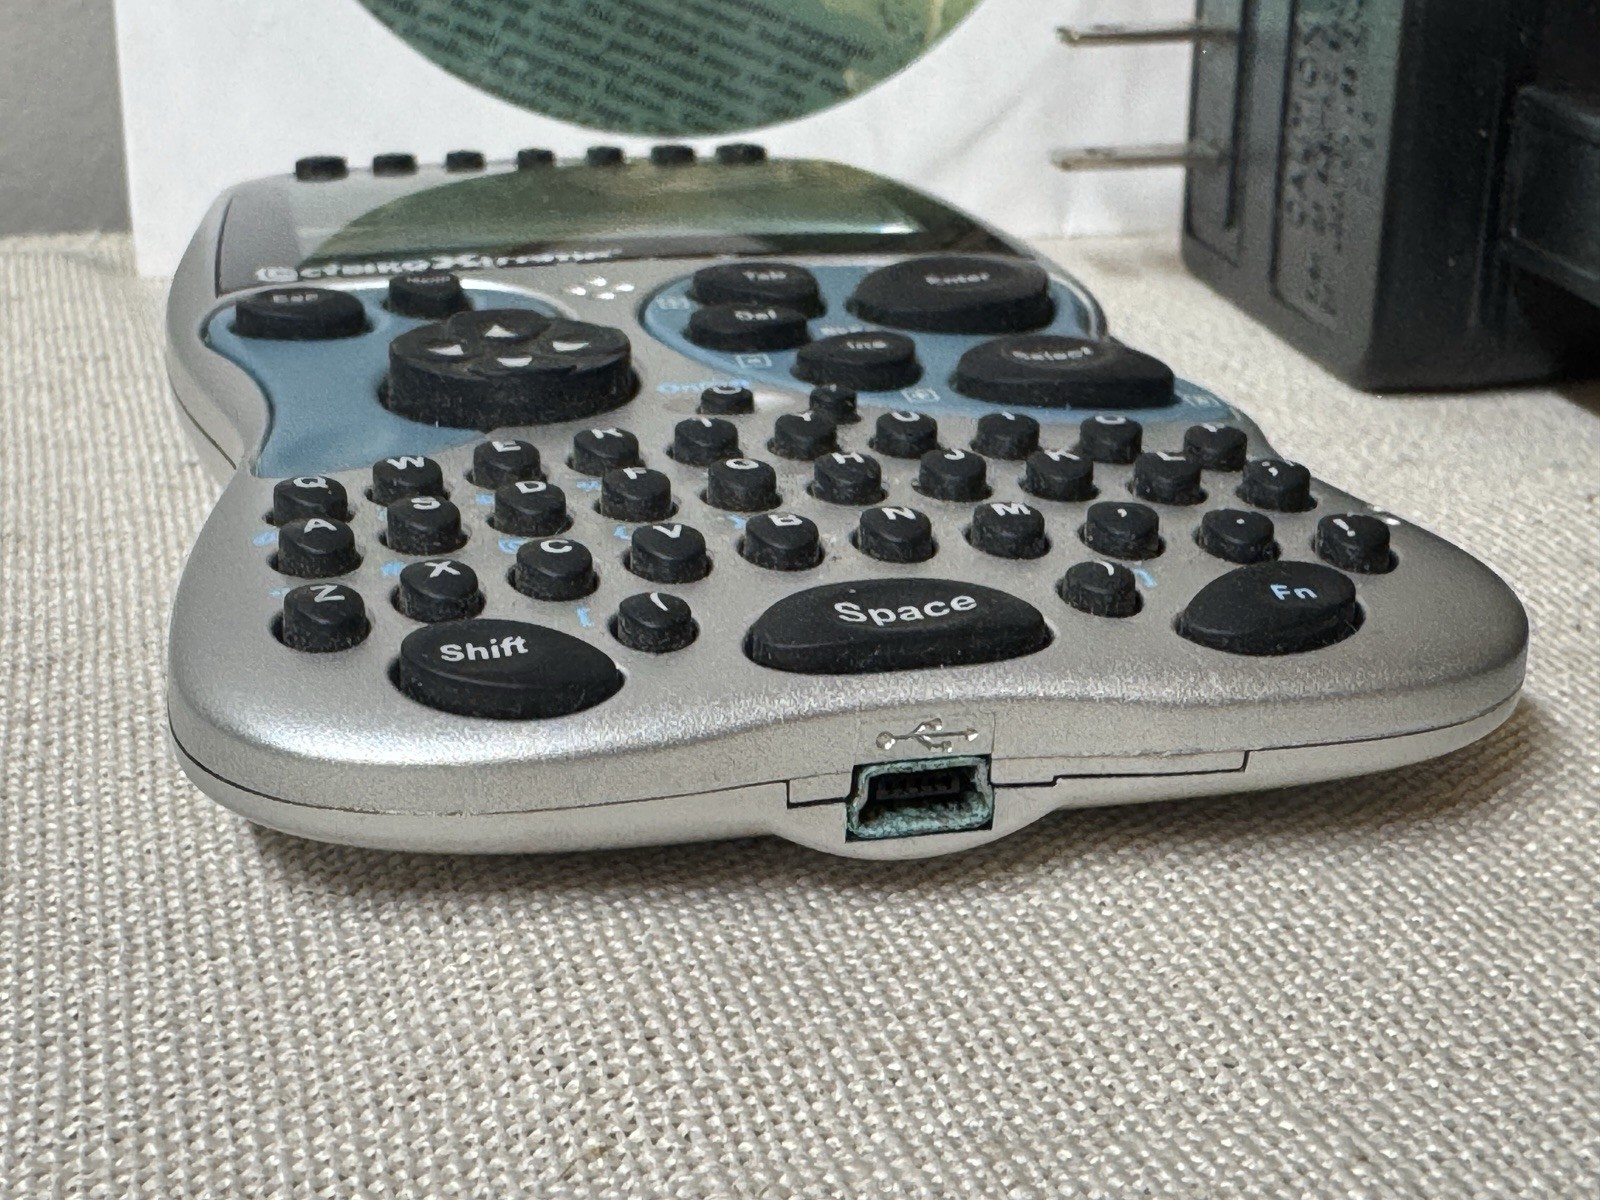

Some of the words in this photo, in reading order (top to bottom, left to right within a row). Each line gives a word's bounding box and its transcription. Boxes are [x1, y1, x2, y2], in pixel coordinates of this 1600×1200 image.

[924, 272, 990, 285] Enter
[387, 456, 425, 471] W
[293, 476, 330, 489] Q
[514, 480, 547, 494] D
[881, 506, 918, 521] N
[990, 502, 1032, 517] M
[304, 518, 337, 534] A
[652, 524, 683, 539] V
[1332, 517, 1356, 538] !
[540, 539, 573, 554] C
[424, 559, 462, 578] X
[309, 583, 346, 603] Z
[1270, 584, 1318, 601] Fn
[834, 594, 978, 627] Space
[439, 635, 529, 662] Shift
